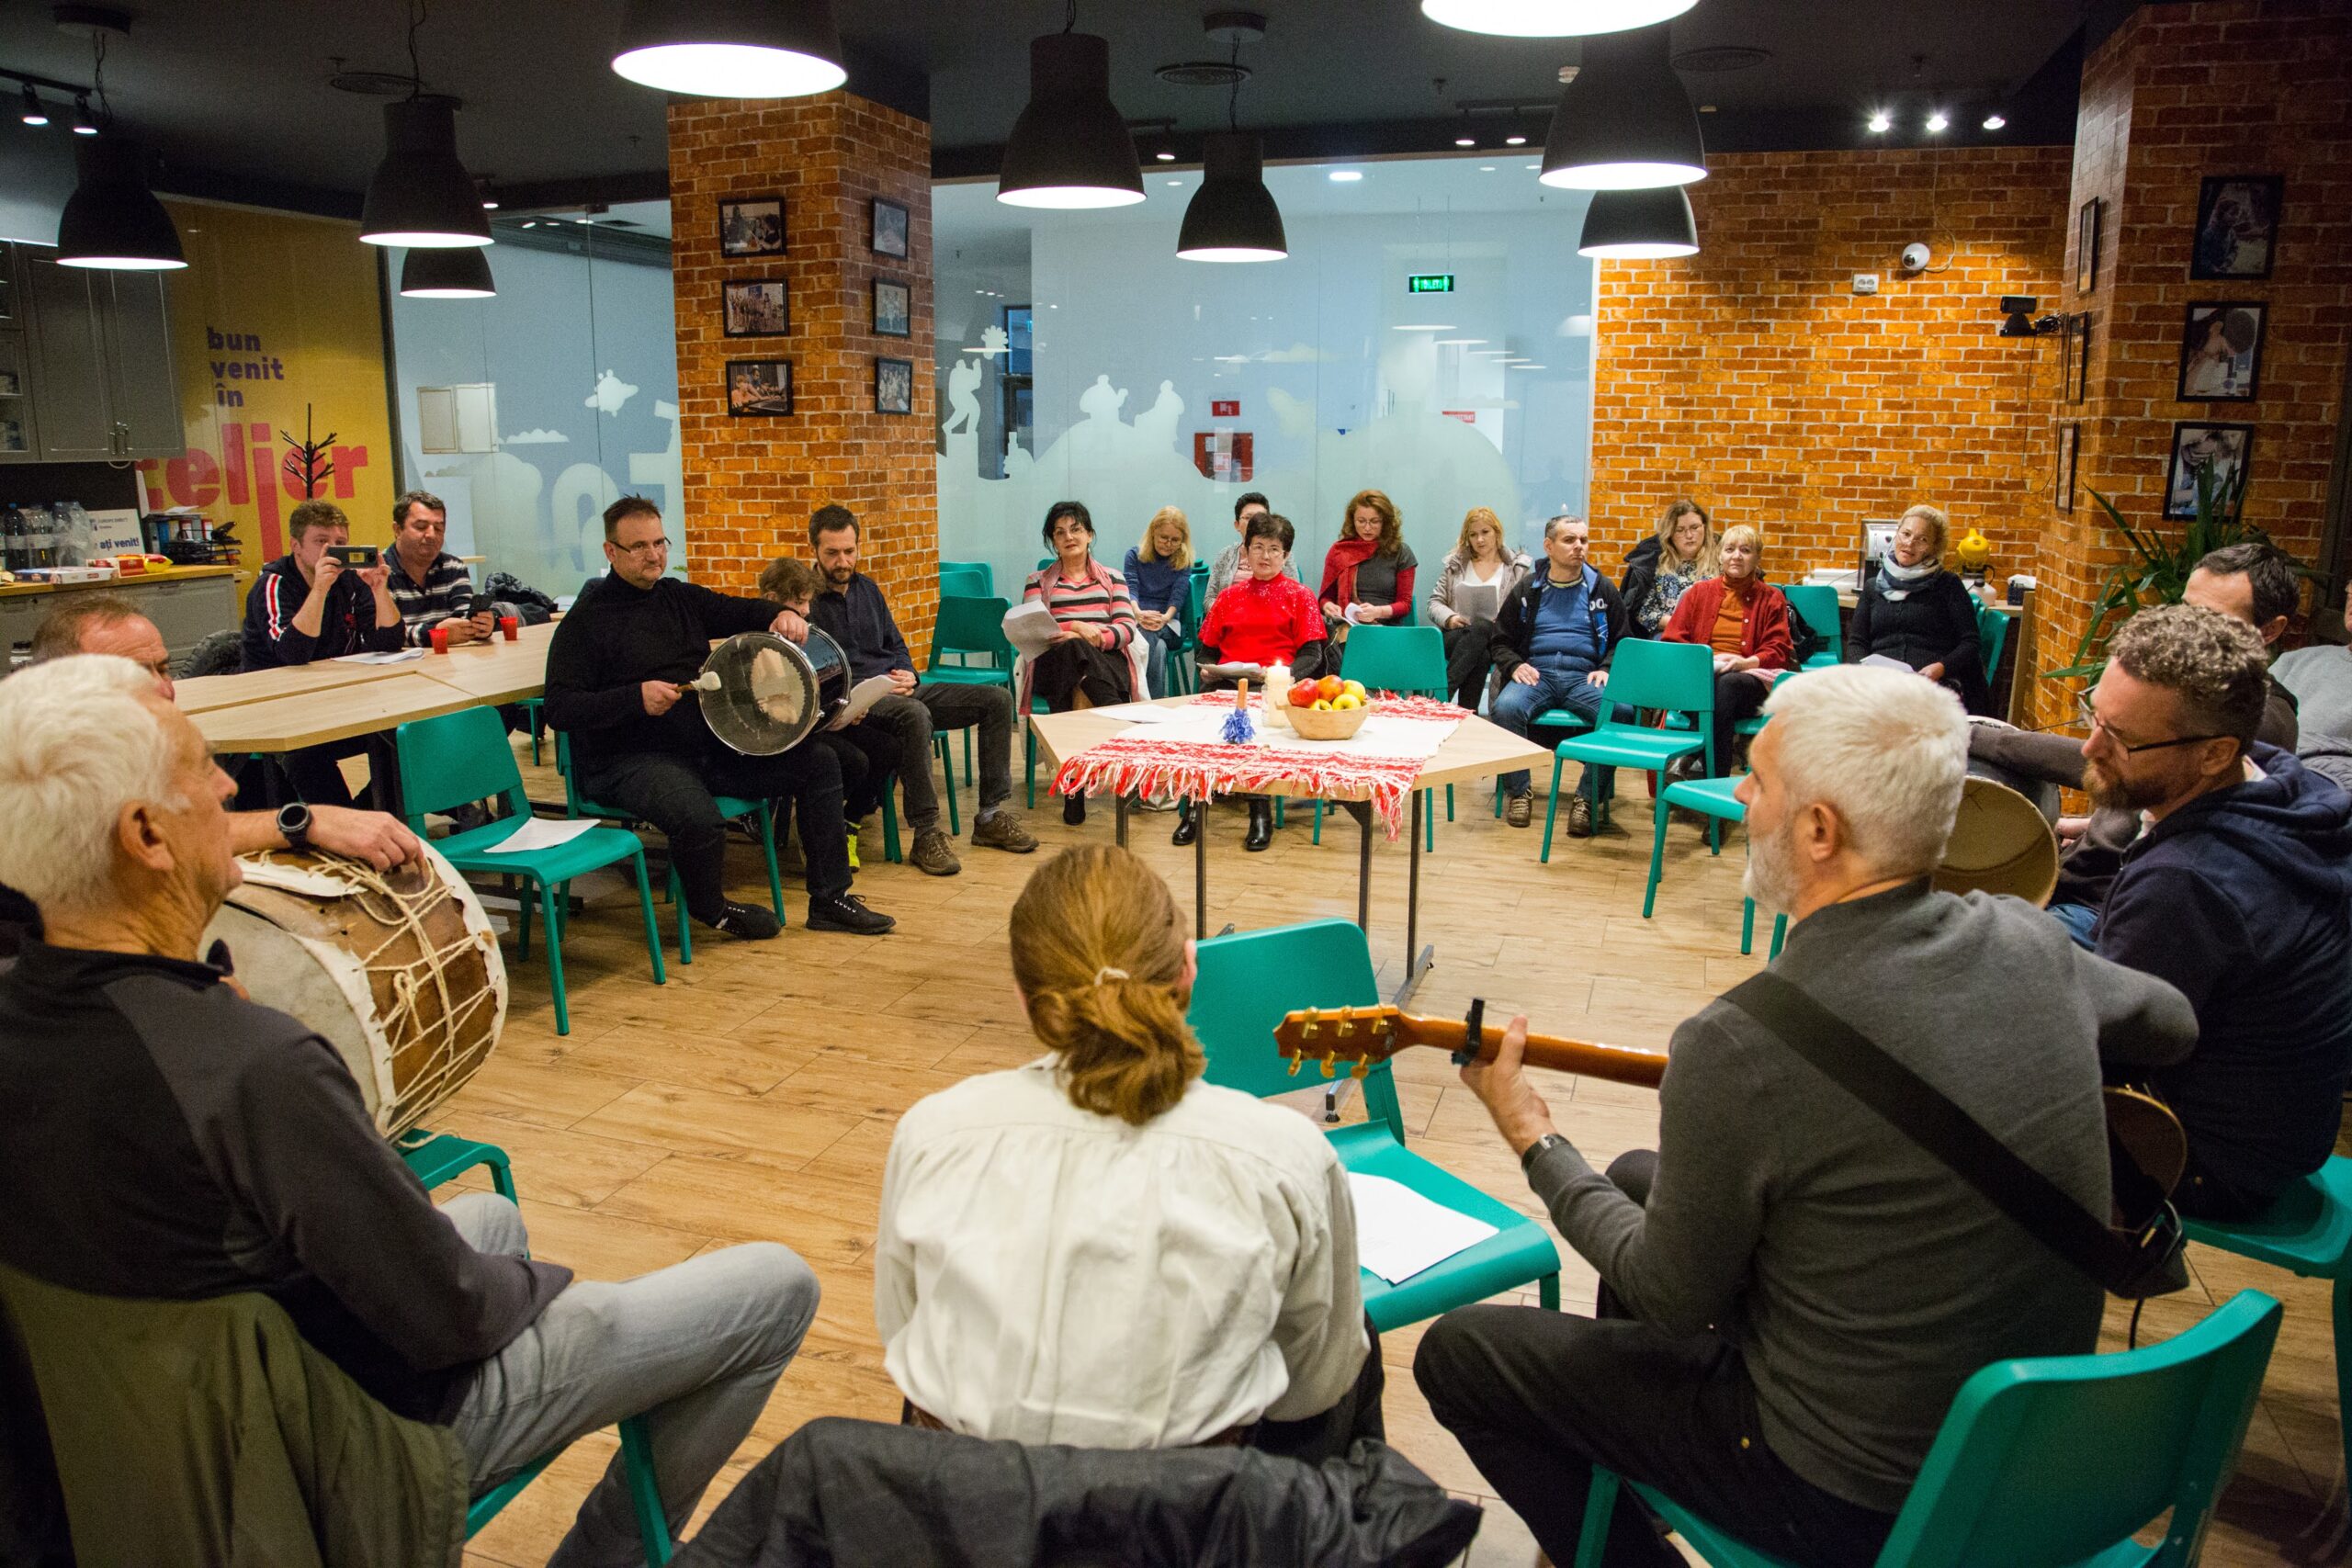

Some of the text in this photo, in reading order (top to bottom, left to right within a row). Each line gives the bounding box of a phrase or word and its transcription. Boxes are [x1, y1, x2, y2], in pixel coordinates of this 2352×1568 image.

[207, 326, 262, 352] bun
[210, 355, 285, 380] venit
[216, 382, 244, 407] în
[114, 537, 140, 547] venit!
